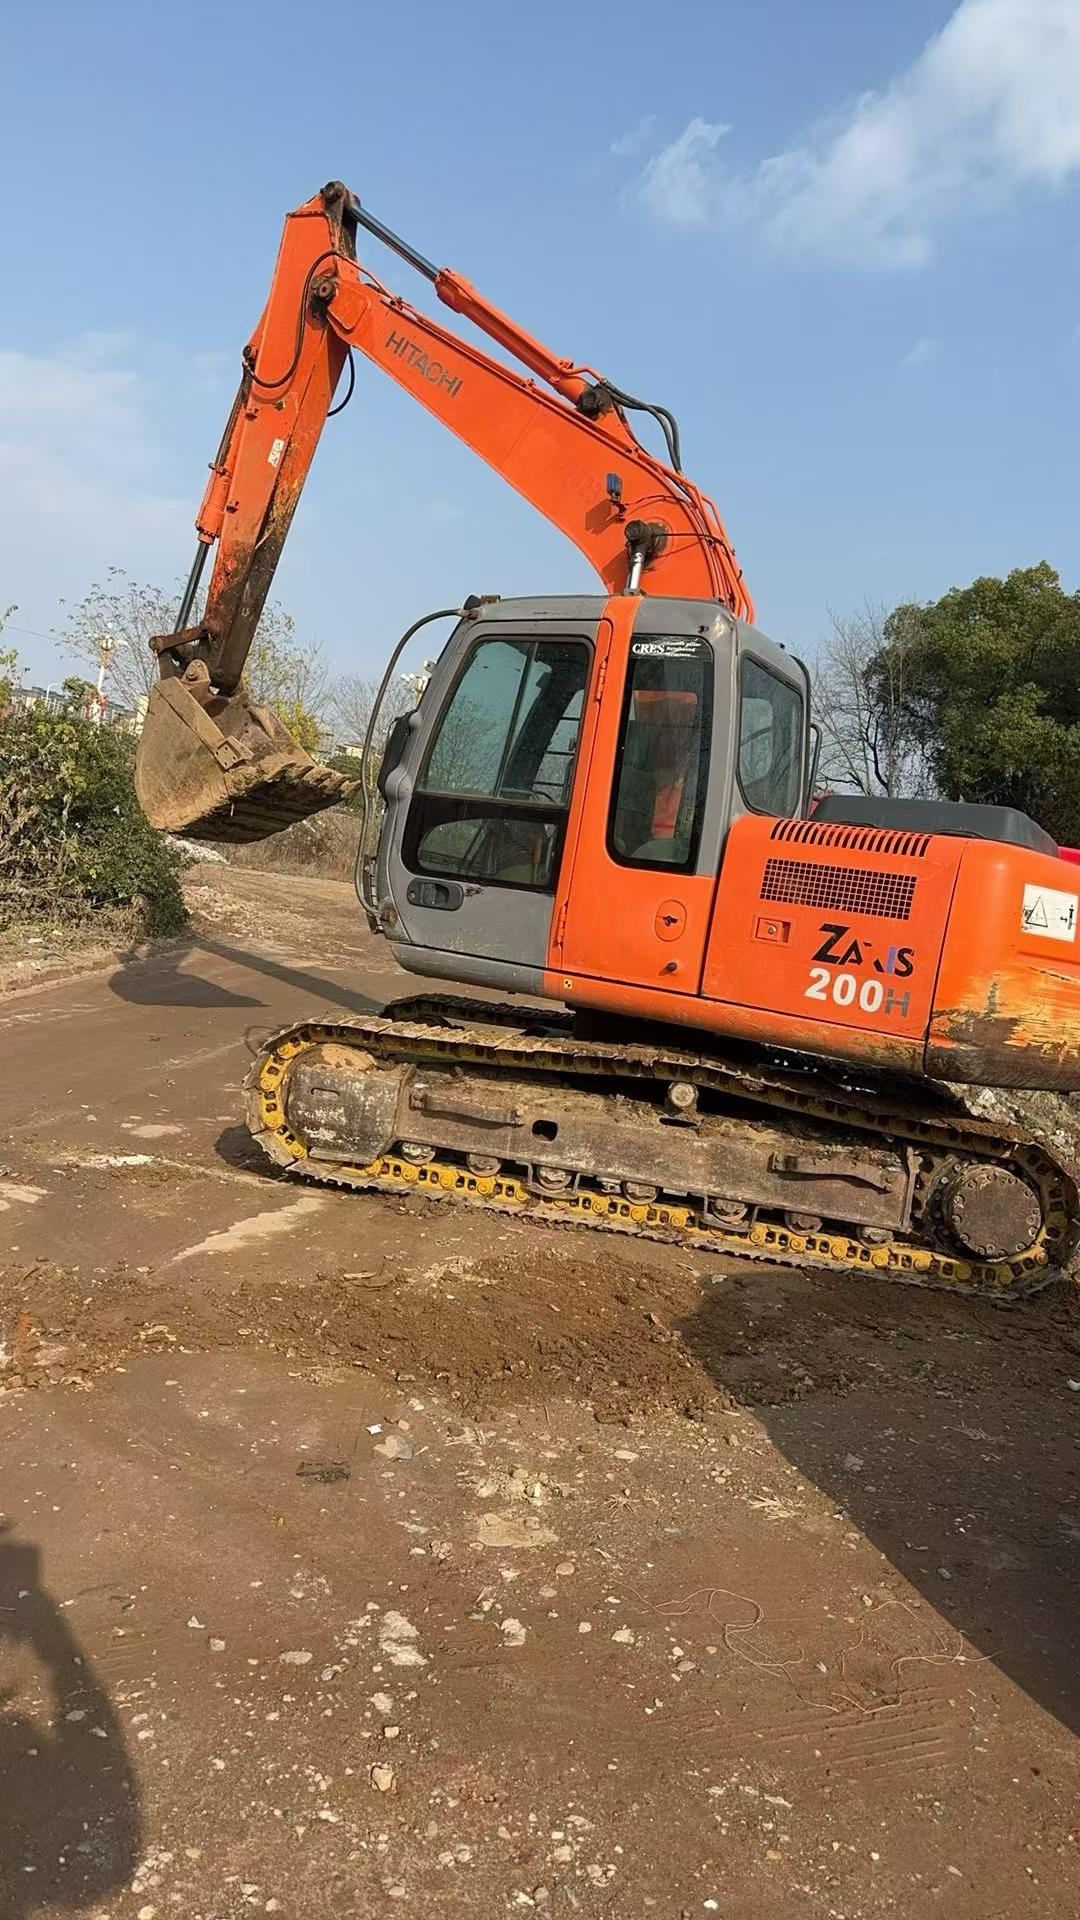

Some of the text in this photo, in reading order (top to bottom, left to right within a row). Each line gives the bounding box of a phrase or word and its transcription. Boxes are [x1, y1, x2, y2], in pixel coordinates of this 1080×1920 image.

[385, 331, 463, 398] HITACHI
[632, 643, 665, 655] CRES
[804, 967, 911, 1018] 200H
